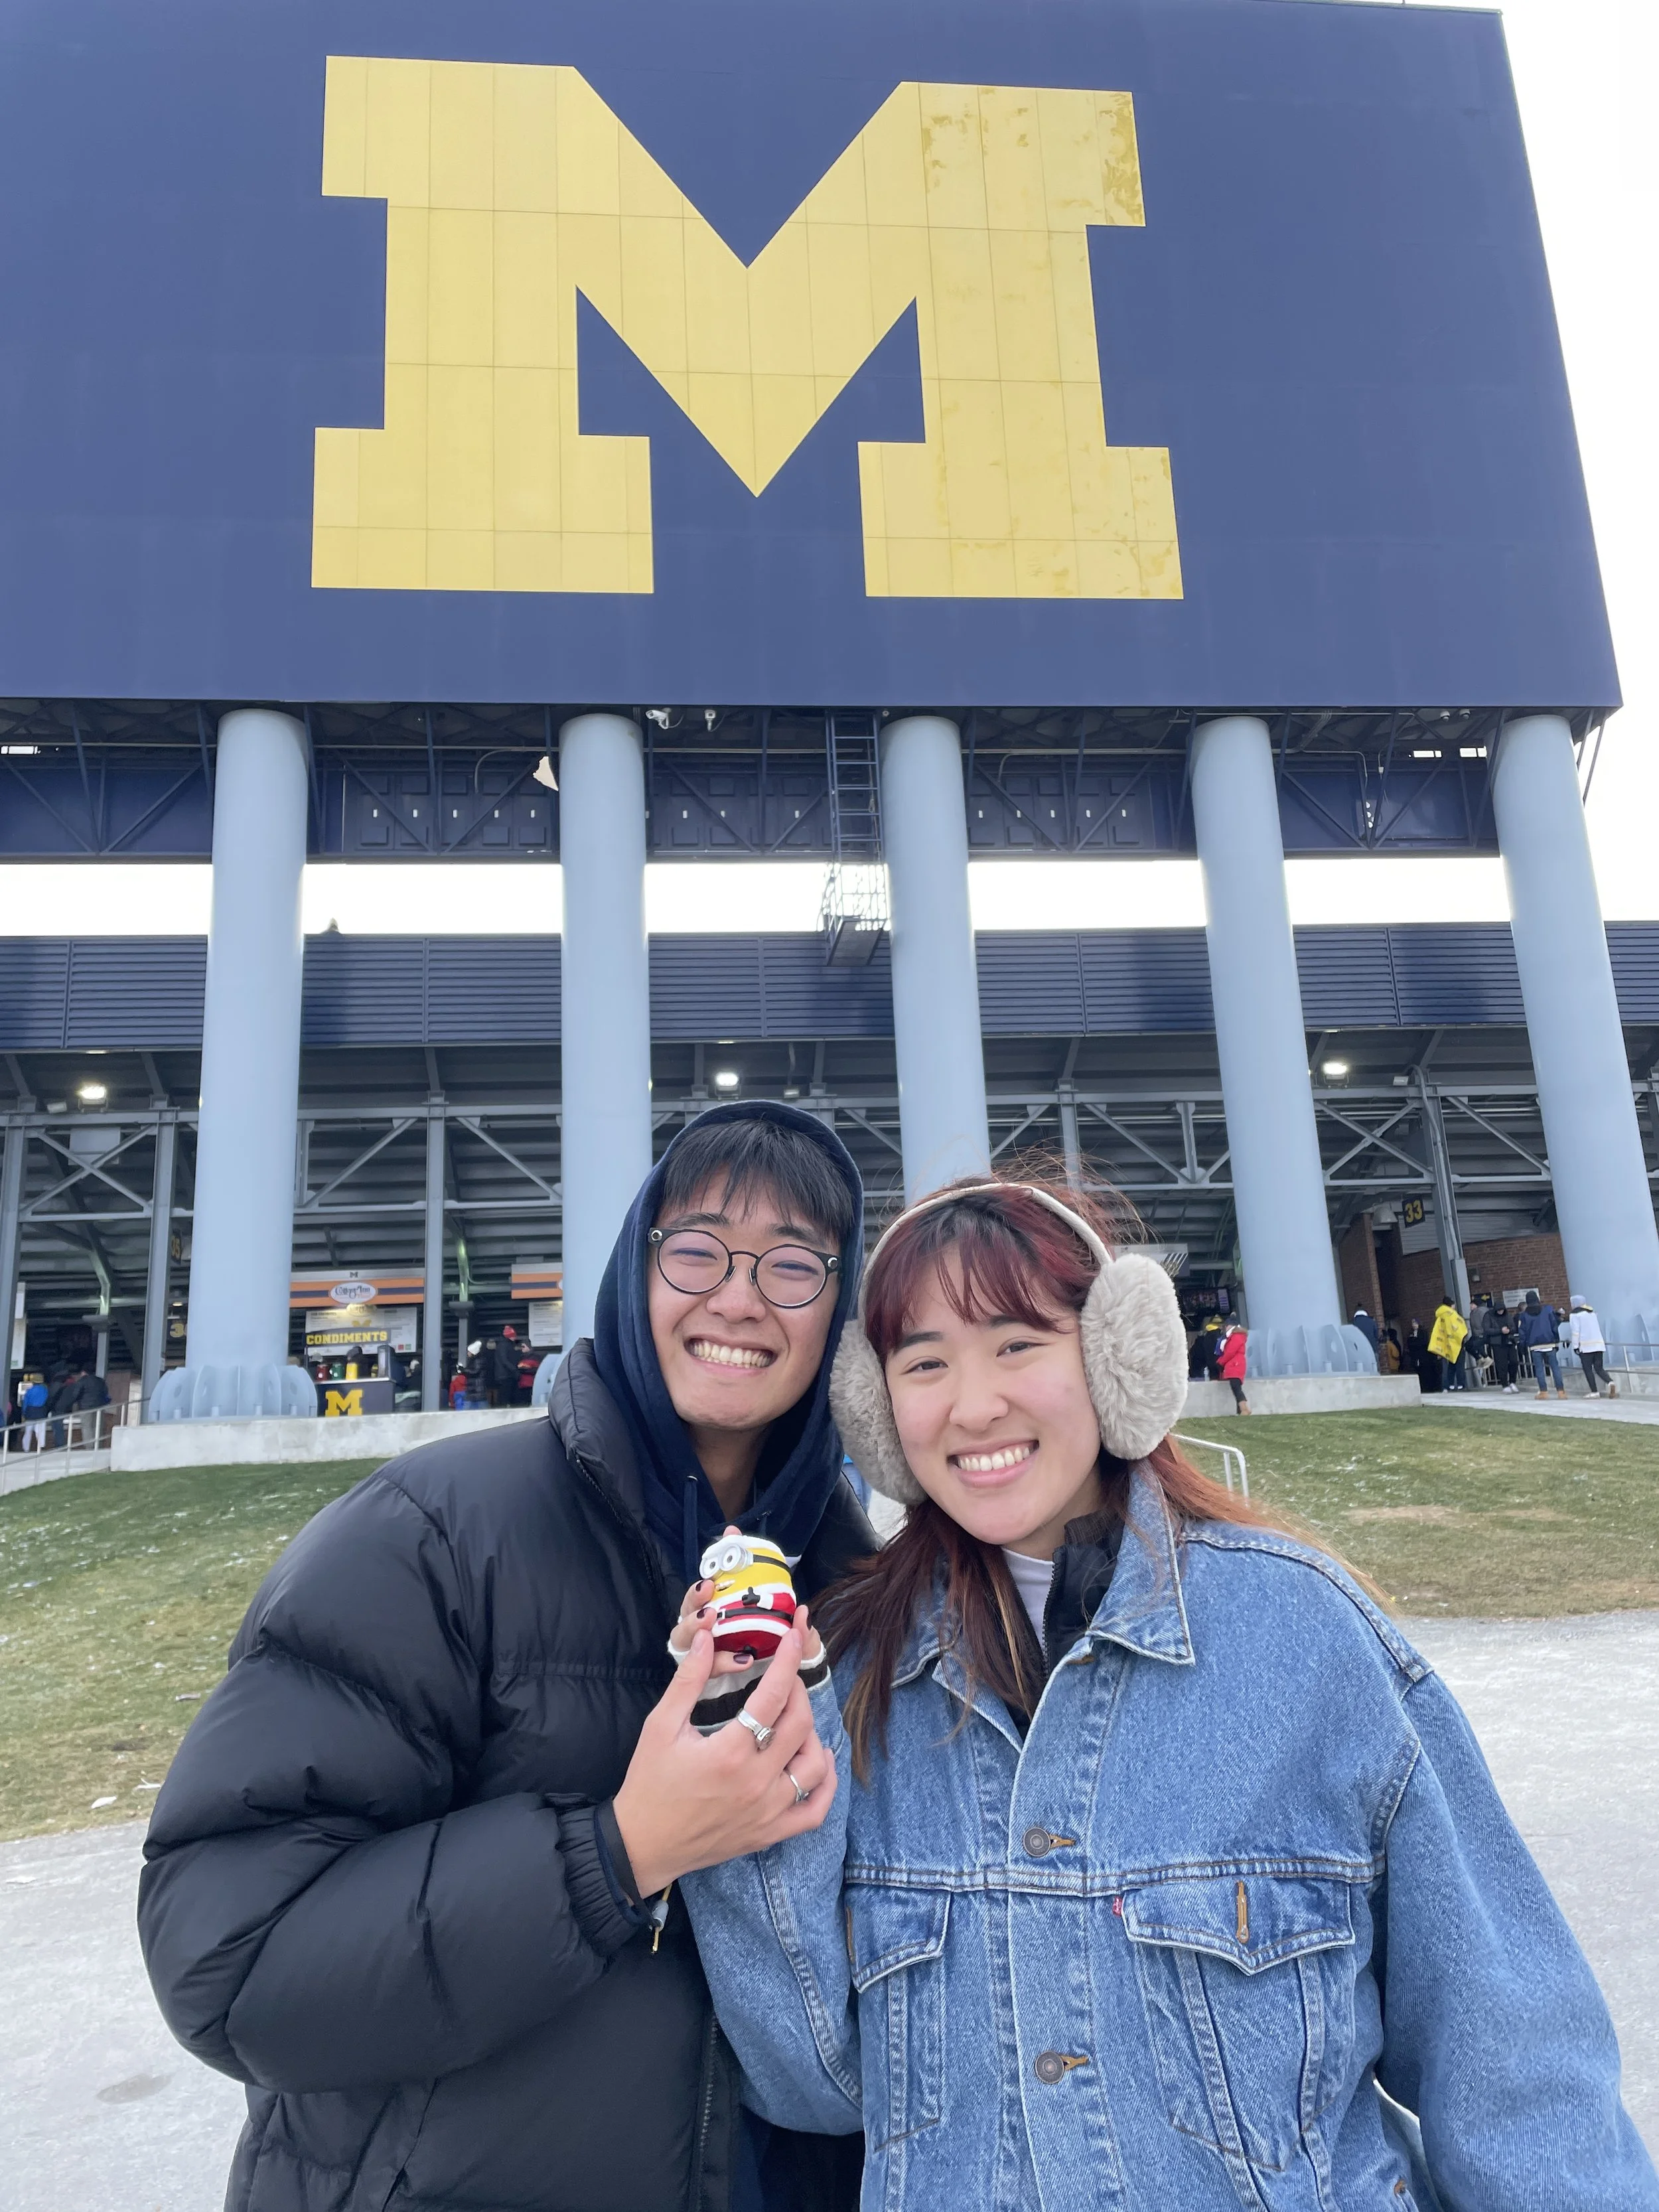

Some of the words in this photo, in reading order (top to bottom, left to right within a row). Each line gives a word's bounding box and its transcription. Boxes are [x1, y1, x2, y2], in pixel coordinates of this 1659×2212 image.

[311, 55, 1183, 599] M
[1406, 1200, 1423, 1222] 33
[306, 1331, 388, 1345] CONDIMENTS
[325, 1389, 363, 1417] M
